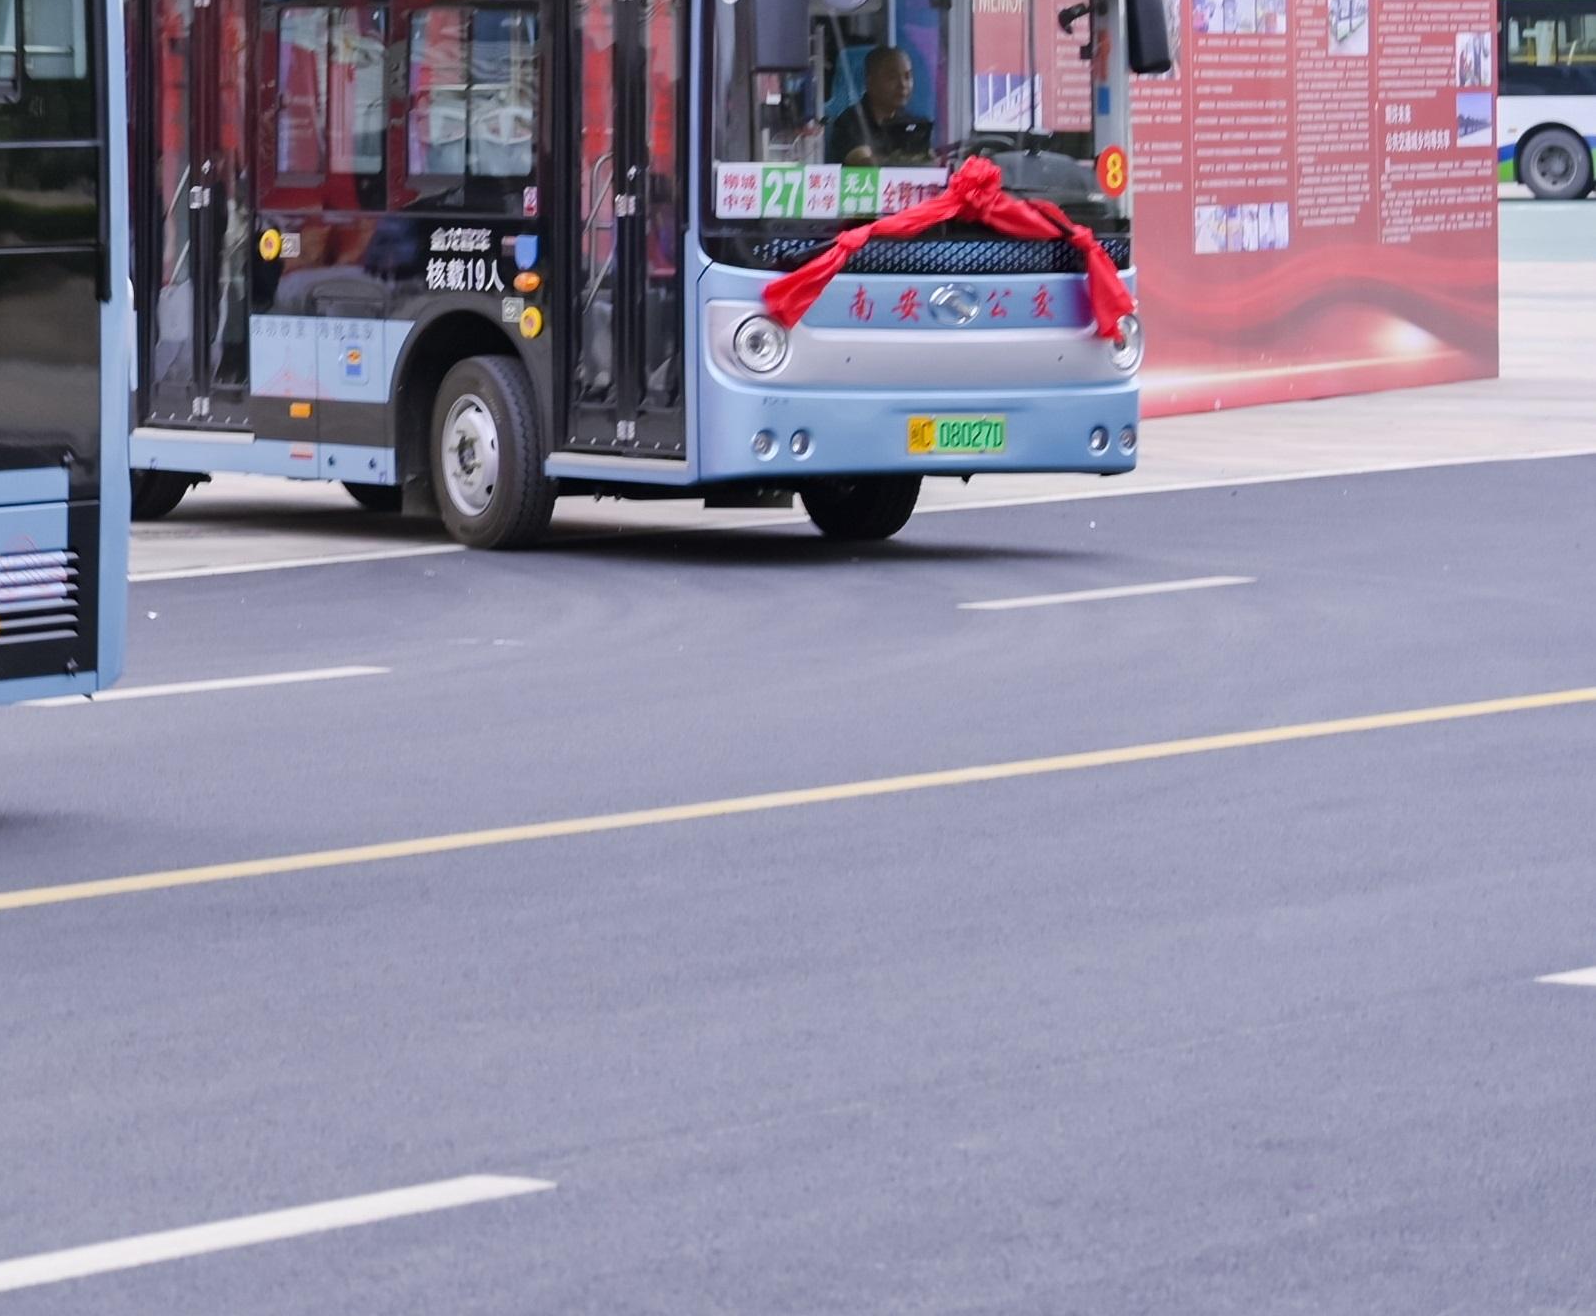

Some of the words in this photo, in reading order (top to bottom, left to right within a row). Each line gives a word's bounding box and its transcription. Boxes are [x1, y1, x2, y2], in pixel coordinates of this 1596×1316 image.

[843, 173, 875, 194] 无人
[1106, 152, 1123, 188] 8
[763, 171, 802, 217] 27
[426, 258, 505, 292] 核载19人
